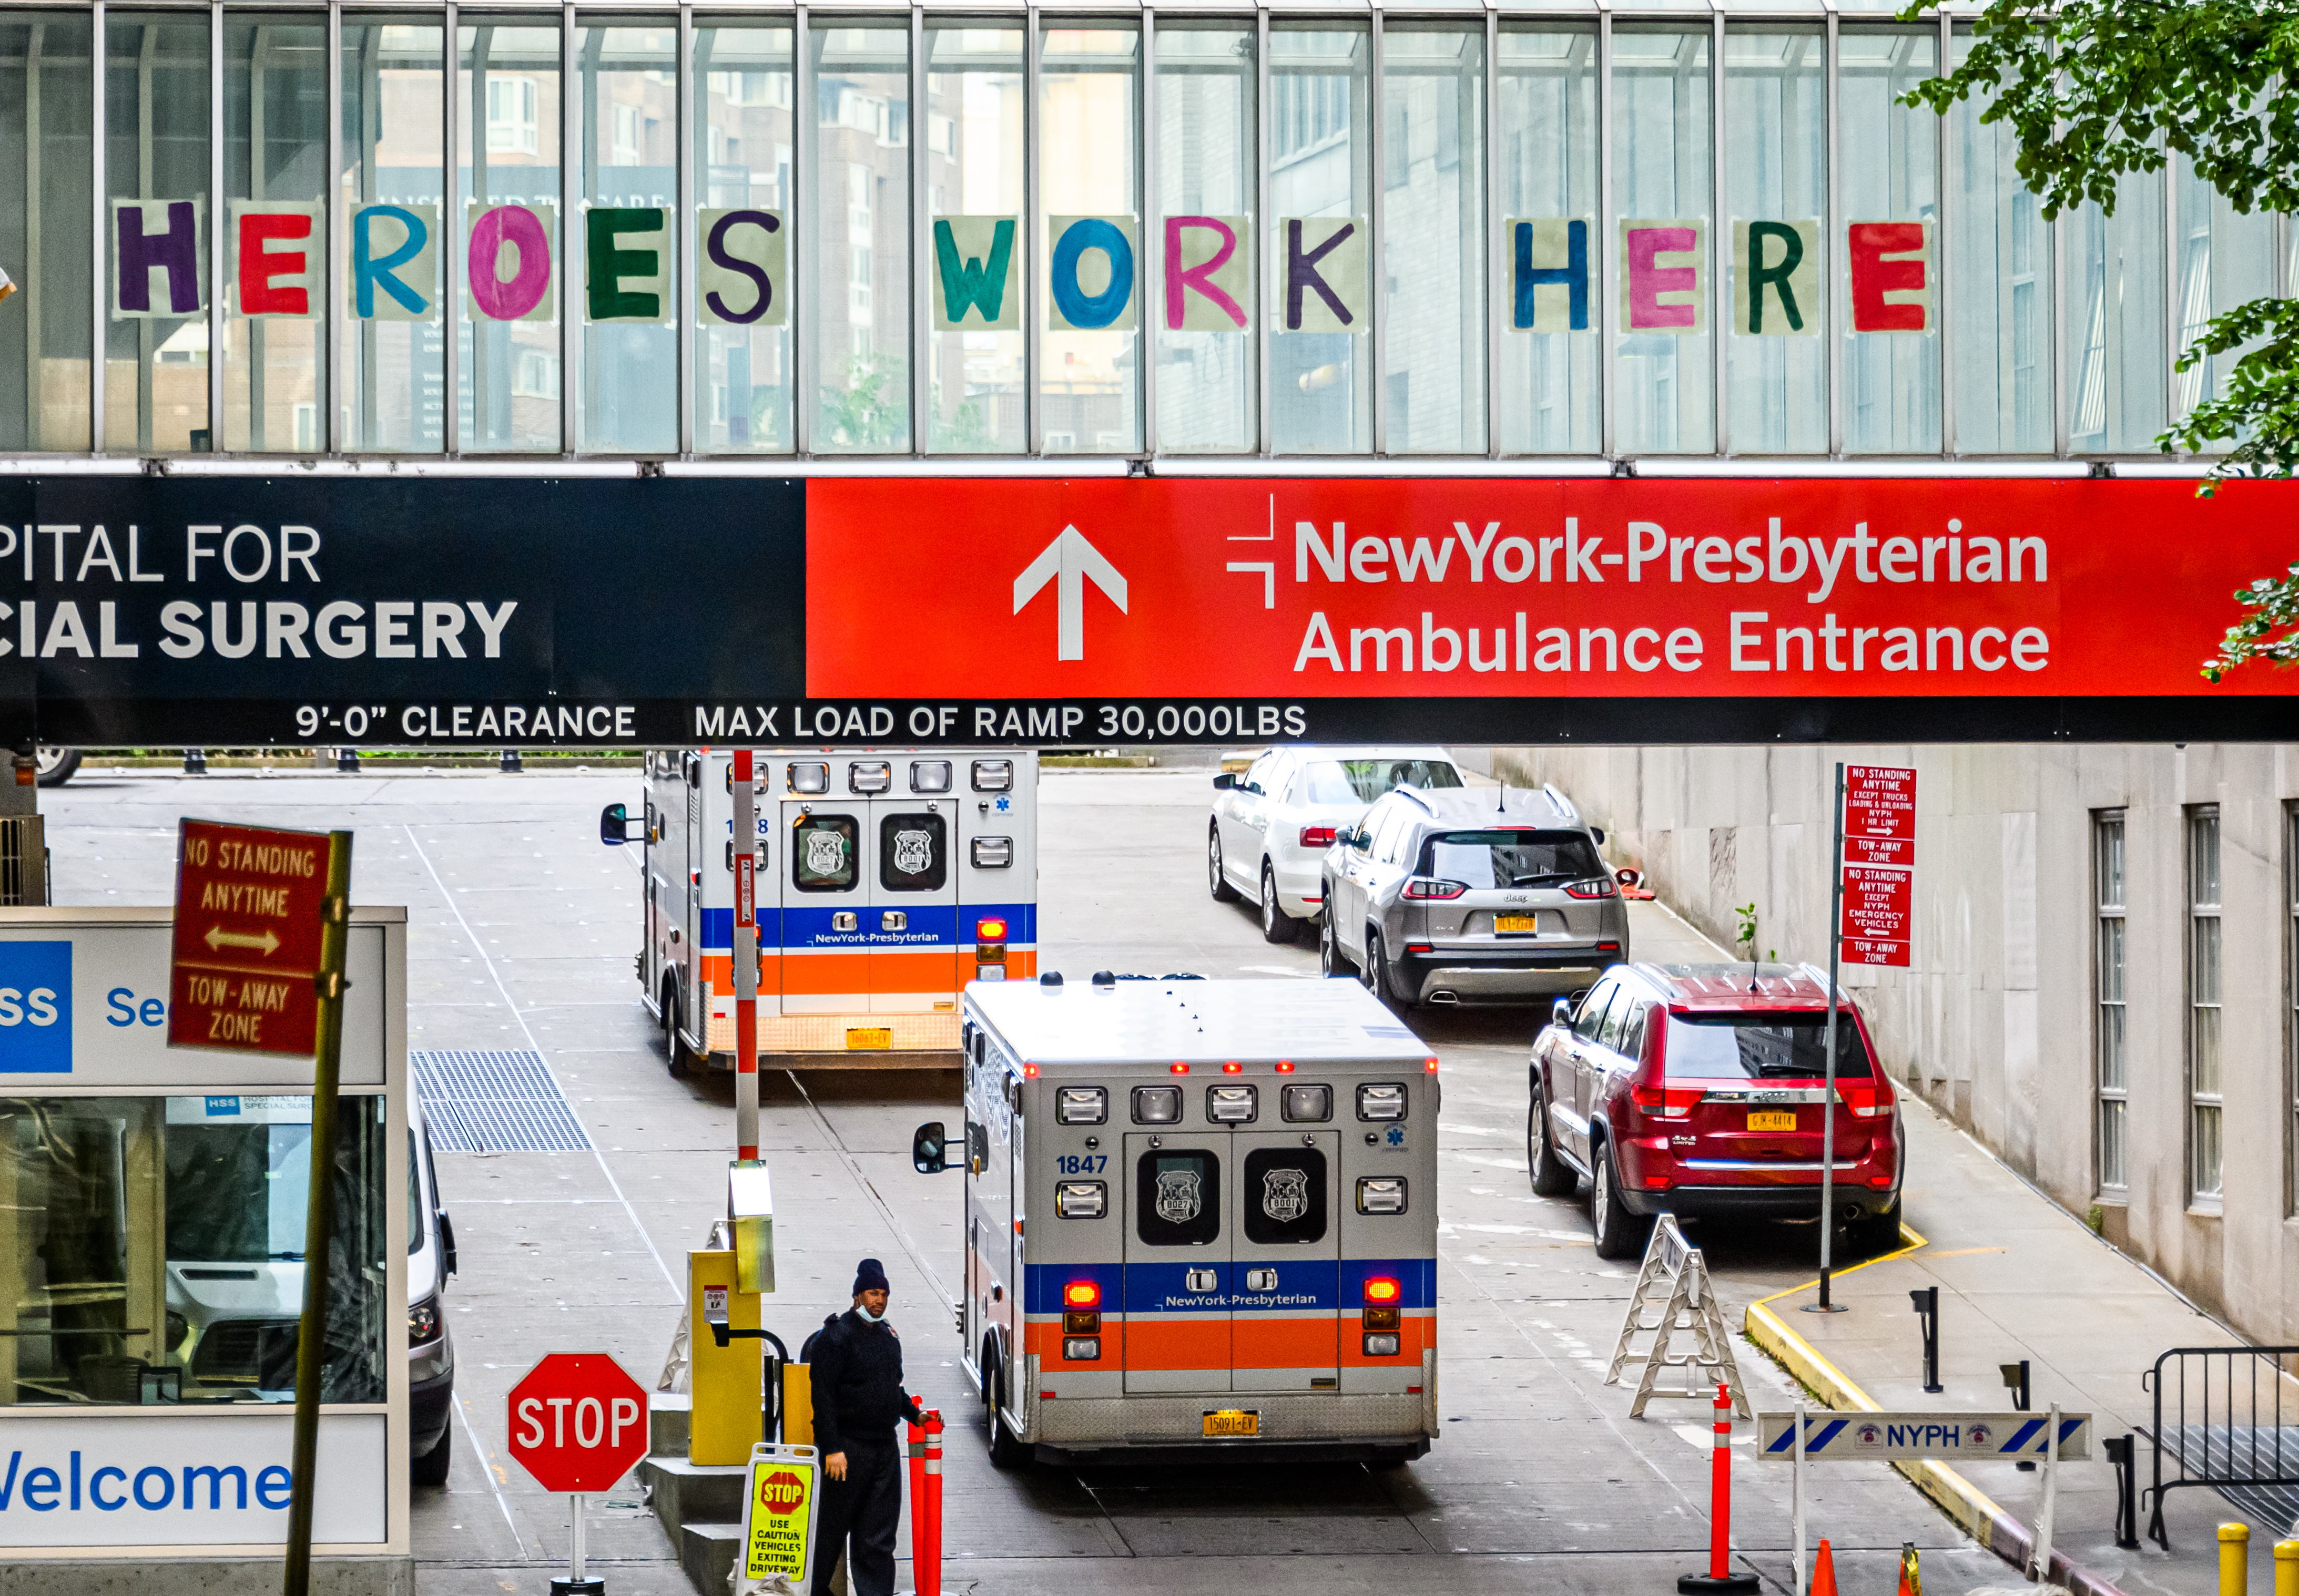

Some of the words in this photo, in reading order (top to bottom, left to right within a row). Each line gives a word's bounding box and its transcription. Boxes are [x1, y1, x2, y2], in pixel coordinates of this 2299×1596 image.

[117, 202, 780, 324] HEROES
[934, 216, 1355, 330] WORK
[1514, 220, 1926, 334] HERE
[187, 524, 321, 583] FOR
[1295, 517, 2048, 603] NewYork-Presbyterian
[0, 600, 139, 658] IAL
[158, 600, 518, 659] SURGERY
[1294, 611, 1704, 673] Ambulance
[1730, 611, 2050, 673] Entrance
[402, 706, 636, 736] CLEARANCE
[695, 706, 779, 736] MAX
[795, 706, 894, 736] LOAD
[909, 706, 957, 736] OF
[975, 706, 1084, 736] RAMP
[1098, 705, 1307, 739] 30,000LBS
[1853, 768, 1865, 778] NO
[1868, 769, 1911, 781] STANDING
[1862, 779, 1900, 791] ANYTIME
[1854, 790, 1879, 800] EXCEPT
[1883, 792, 1908, 802] TRUCKS
[1849, 799, 1873, 808] LOADING
[1881, 801, 1913, 810] UNLOADING
[1869, 810, 1893, 818] NYPH
[726, 819, 769, 834] 18
[1881, 819, 1899, 827] LIMIT
[1858, 840, 1902, 852] TOW-AWAY
[185, 838, 209, 867] NO
[218, 842, 316, 879] STANDING
[1868, 852, 1891, 863] ZONE
[1849, 869, 1861, 879] NO
[1865, 870, 1906, 883] STANDING
[1858, 881, 1896, 894] ANYTIME
[201, 882, 290, 918] ANYTIME
[1503, 893, 1528, 904] Jeep
[1865, 893, 1889, 902] EXCEPT
[1864, 902, 1890, 910] NYPH
[1849, 909, 1904, 920] EMERGENCY
[1854, 918, 1899, 929] VEHICLES
[816, 932, 939, 946] NewYork-Presbyterian
[1854, 941, 1898, 954] TOW-AWAY
[1865, 953, 1887, 964] ZONE
[187, 975, 290, 1014] TOW-AWAY
[209, 1011, 262, 1043] ZONE
[209, 1098, 237, 1108] HSS
[1056, 1155, 1108, 1174] 1847
[1165, 1293, 1317, 1308] NewYork-Presbyterian
[516, 1397, 639, 1449] STOP
[1887, 1424, 1960, 1448] NYPH
[764, 1482, 803, 1503] STOP
[770, 1519, 789, 1529] USE
[757, 1530, 800, 1540] CAUTION
[755, 1541, 801, 1552] VEHICLES
[757, 1552, 796, 1563] EXITING
[750, 1563, 801, 1574] DRIVEWAY
